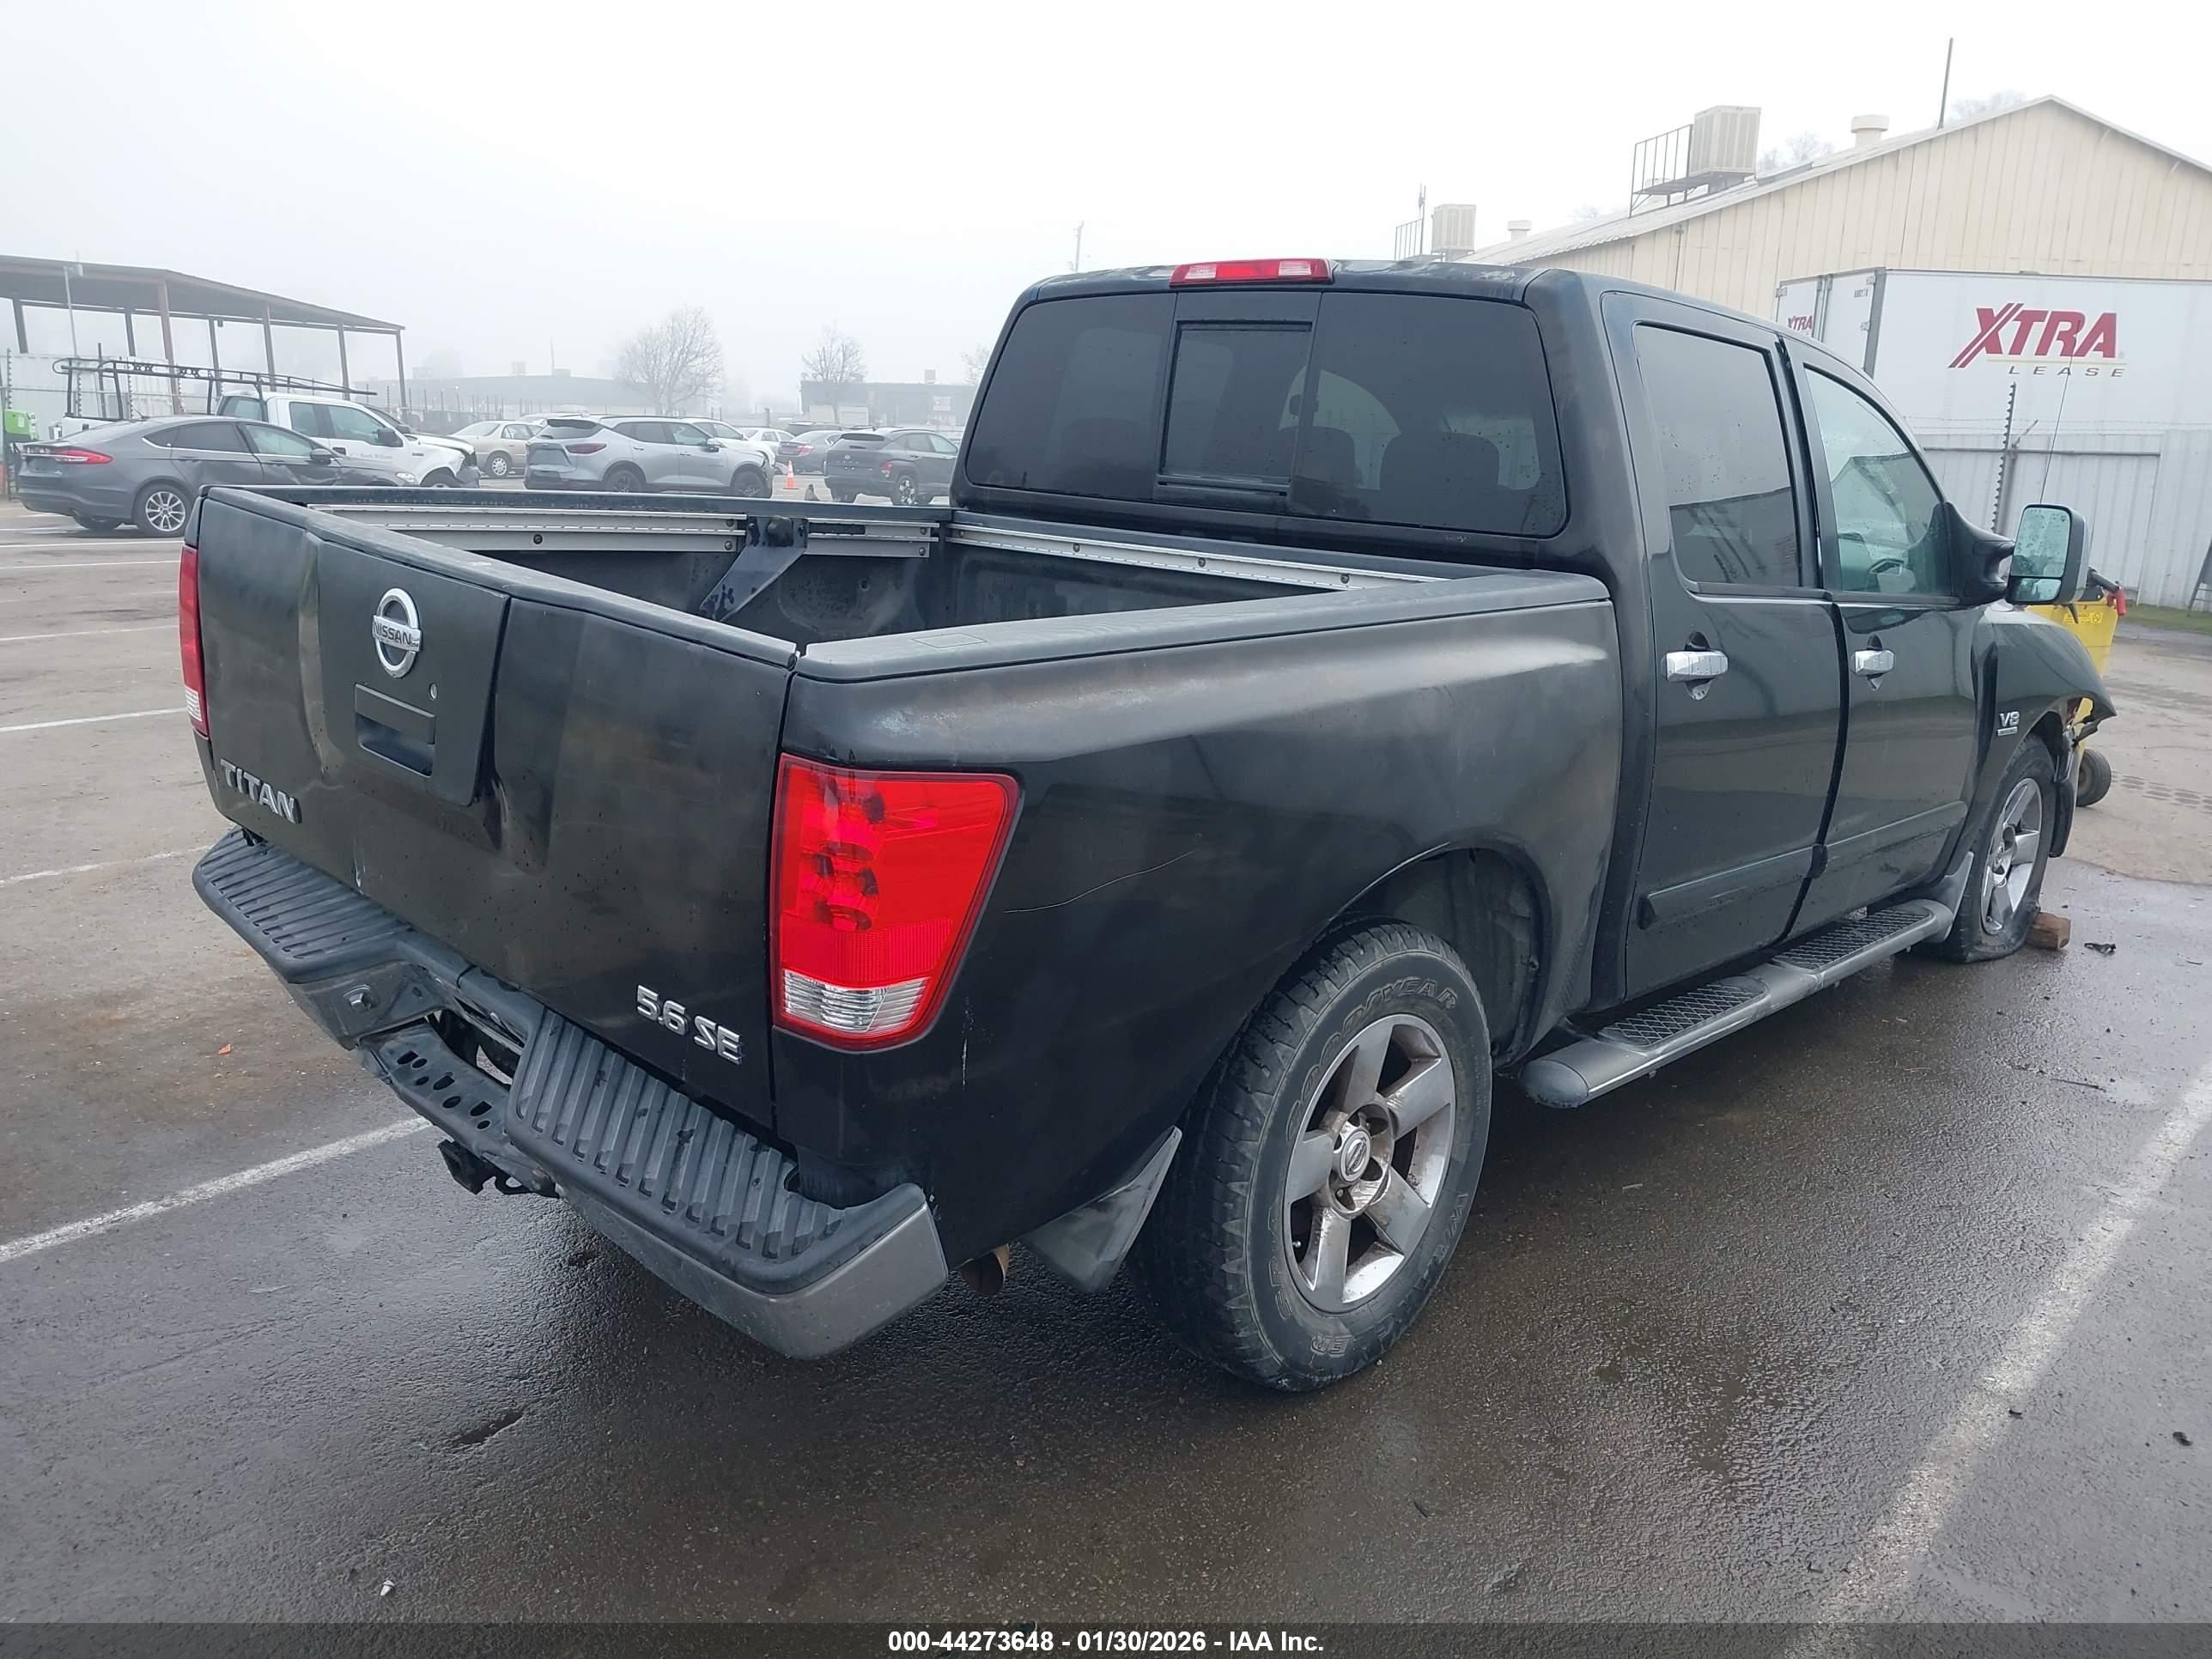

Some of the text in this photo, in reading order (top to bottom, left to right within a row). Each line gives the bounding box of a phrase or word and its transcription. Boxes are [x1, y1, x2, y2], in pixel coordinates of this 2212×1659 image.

[1787, 315, 1813, 331] XTRA
[1948, 303, 2117, 368] XTRA
[2008, 365, 2124, 378] LEASE
[374, 619, 413, 647] NISSAN
[1999, 711, 2021, 728] V8
[220, 758, 298, 824] TITAN
[636, 984, 741, 1066] 5.6 SE
